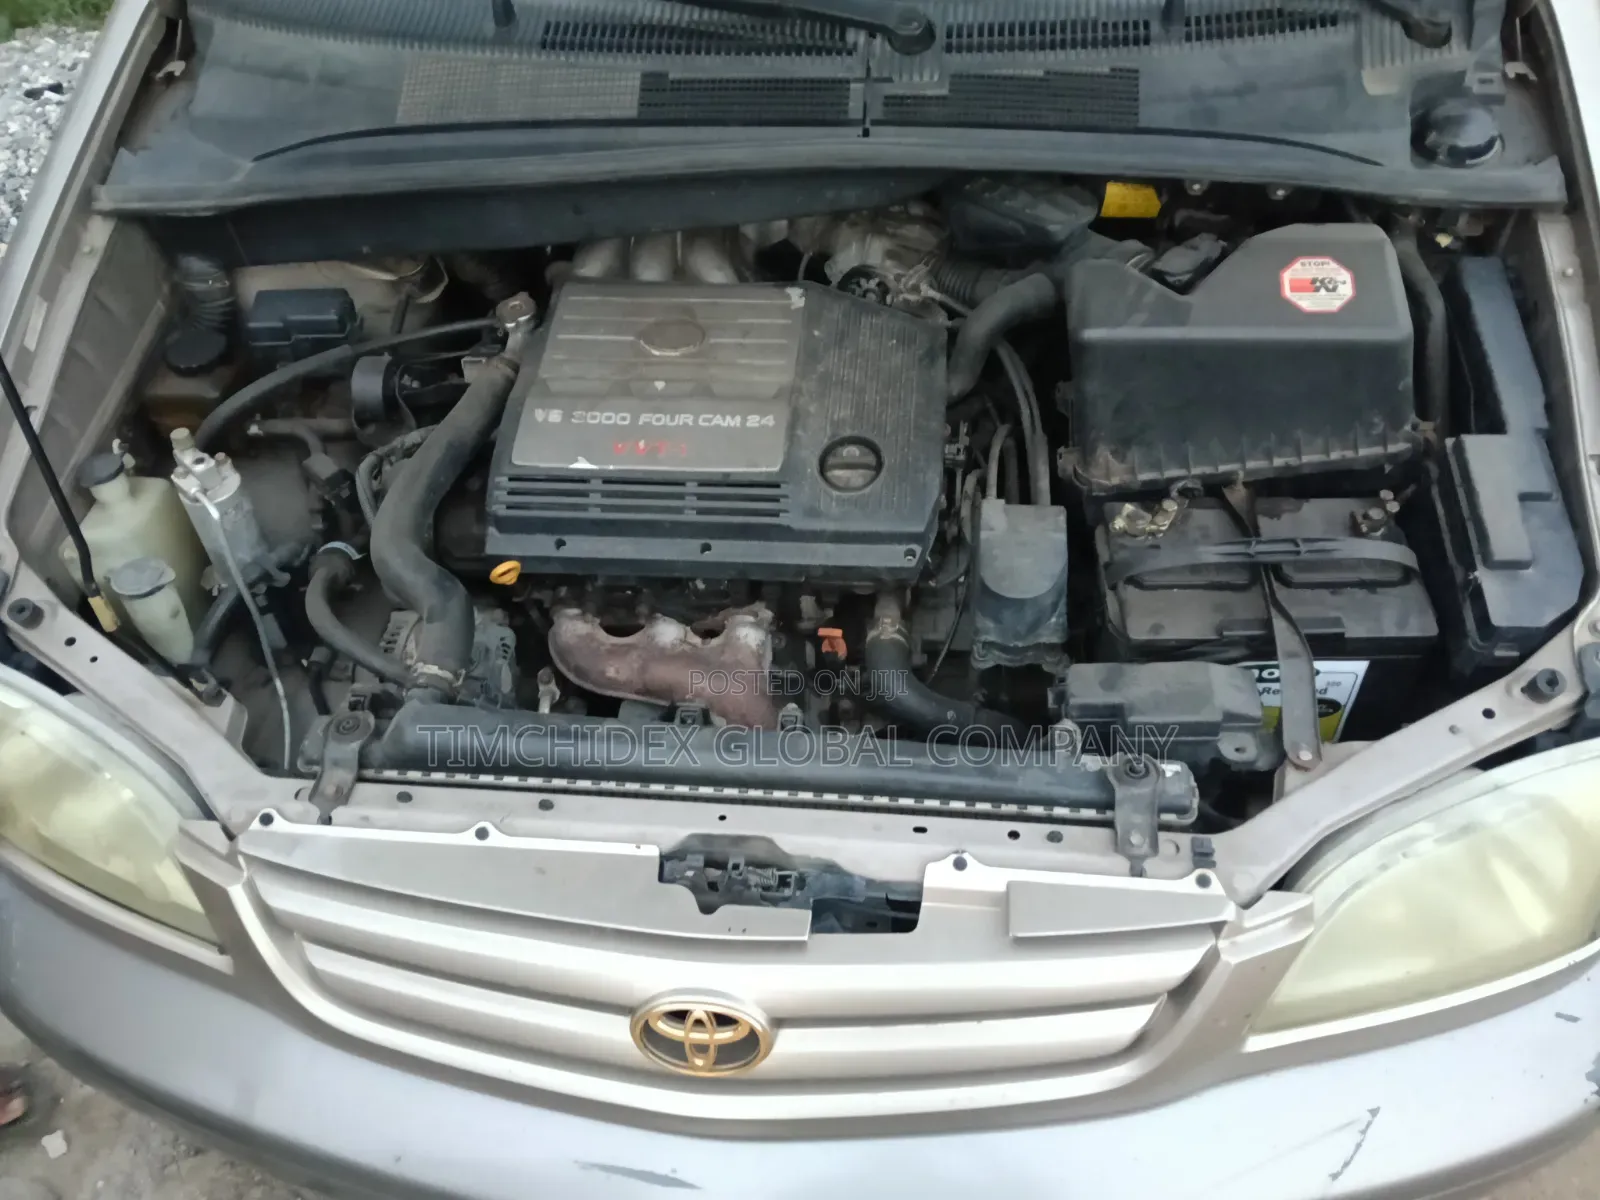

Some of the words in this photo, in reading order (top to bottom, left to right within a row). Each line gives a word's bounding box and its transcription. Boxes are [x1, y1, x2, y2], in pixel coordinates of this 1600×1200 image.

[571, 411, 631, 425] 3000
[638, 413, 694, 427] FOUR
[698, 414, 741, 428] CAM
[745, 414, 775, 428] 24
